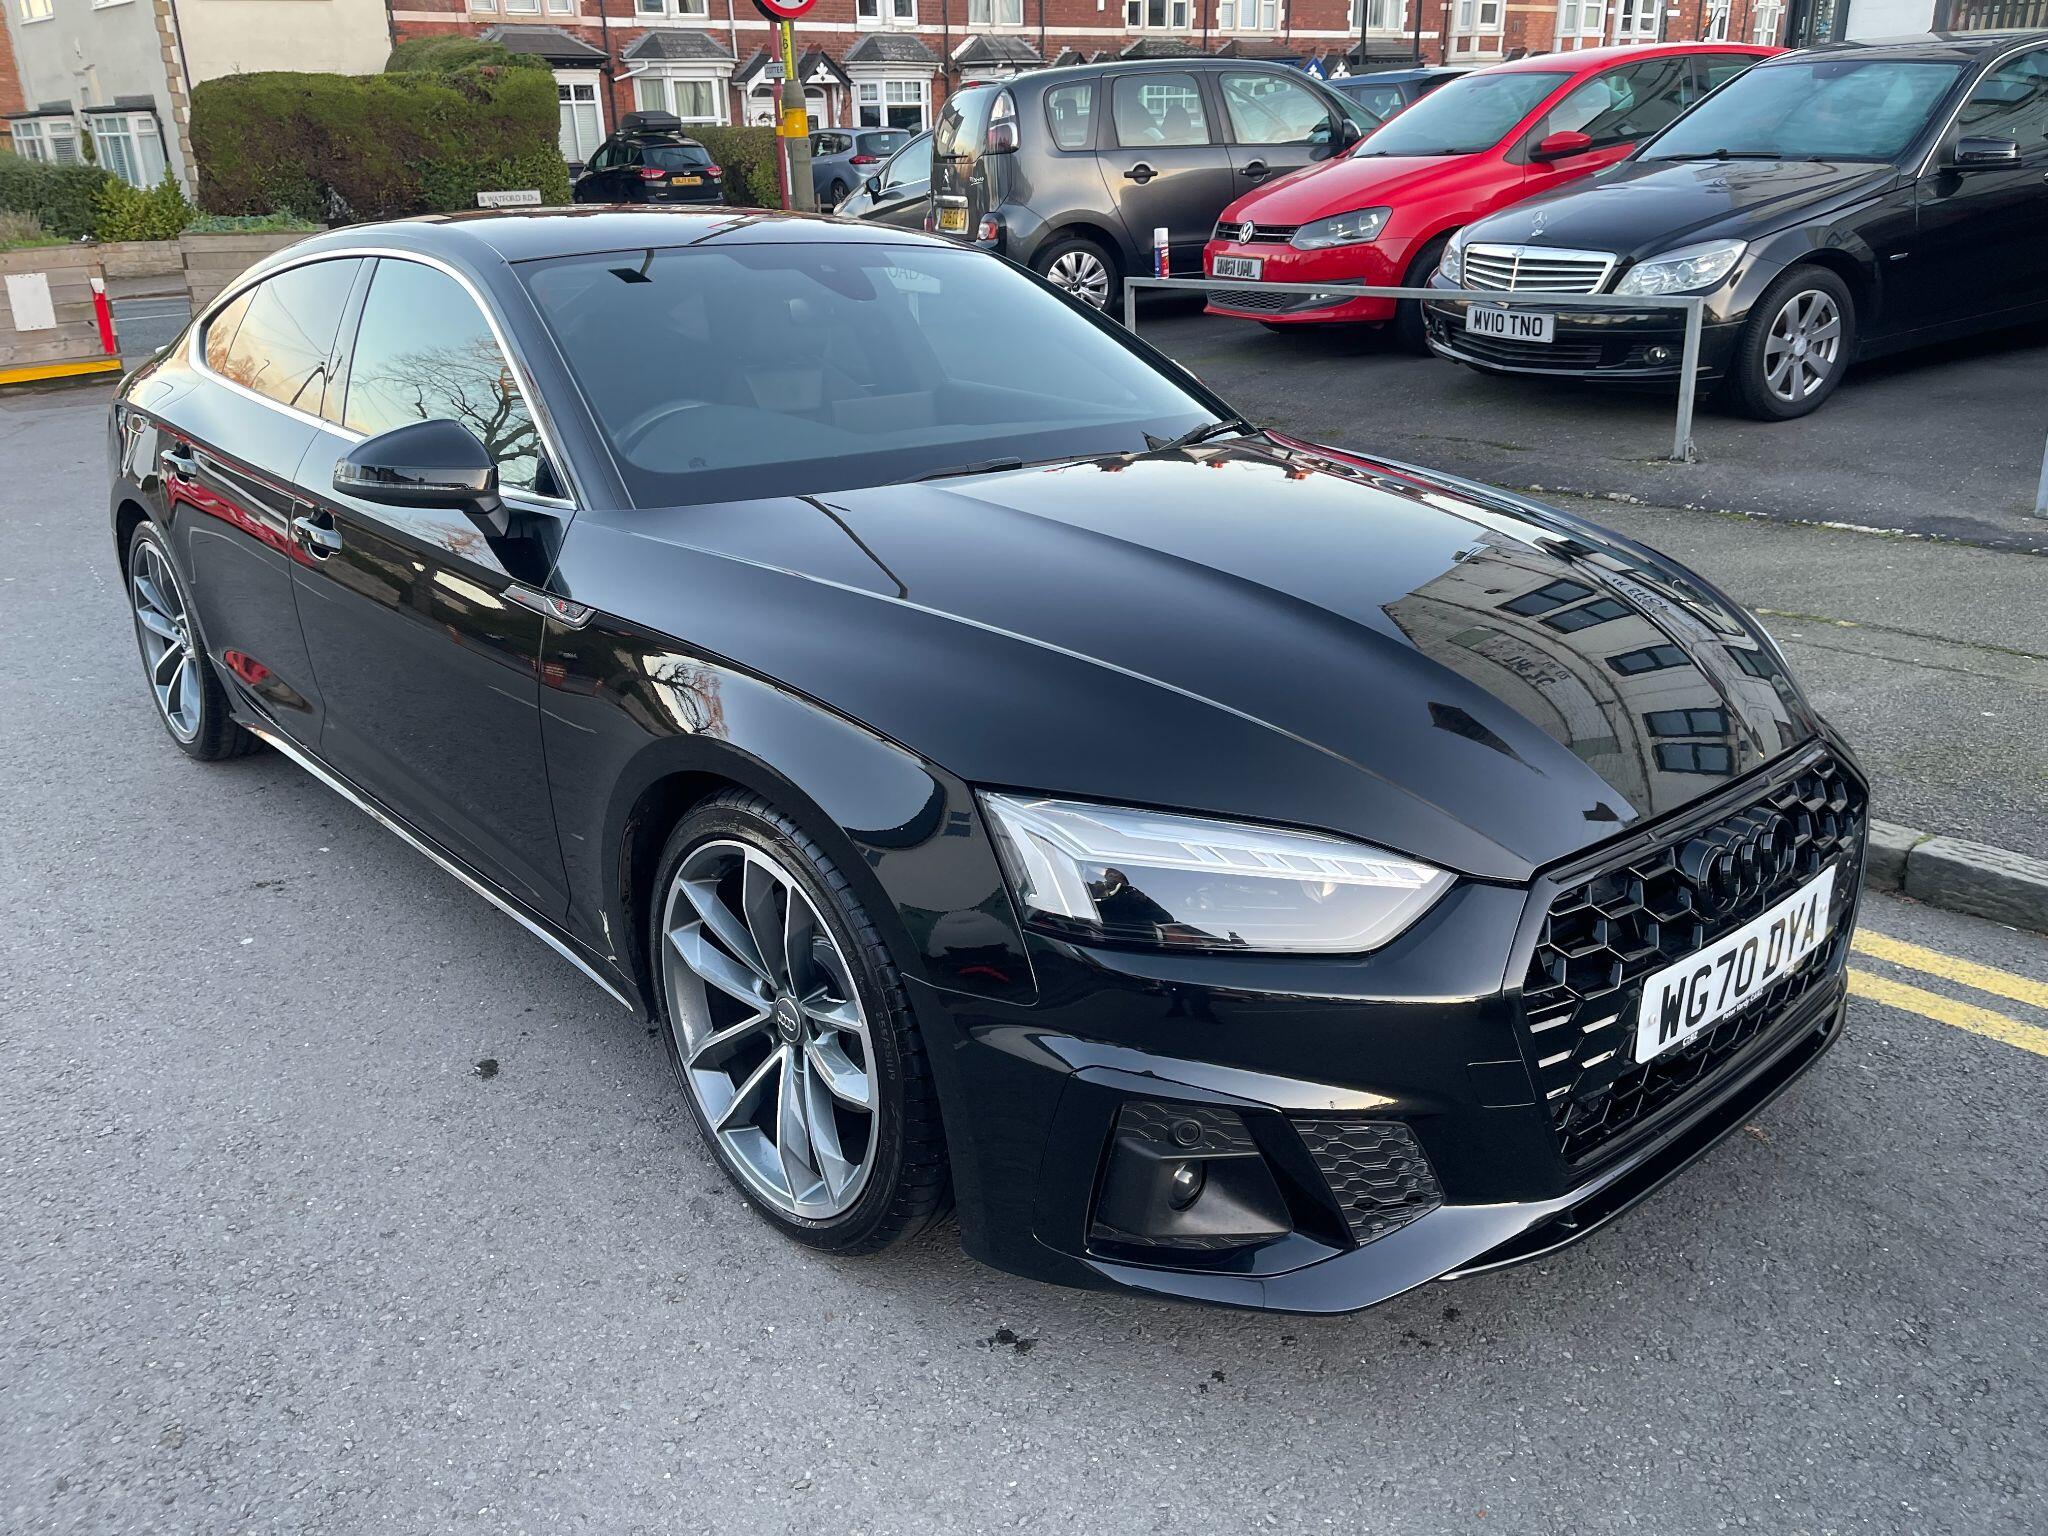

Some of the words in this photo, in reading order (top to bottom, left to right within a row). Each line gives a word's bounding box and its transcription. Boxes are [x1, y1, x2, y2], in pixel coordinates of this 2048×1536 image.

[1474, 310, 1504, 333] MV10
[1509, 314, 1543, 337] TNO
[1659, 936, 1759, 1045] WG70
[1762, 892, 1818, 981] DYA
